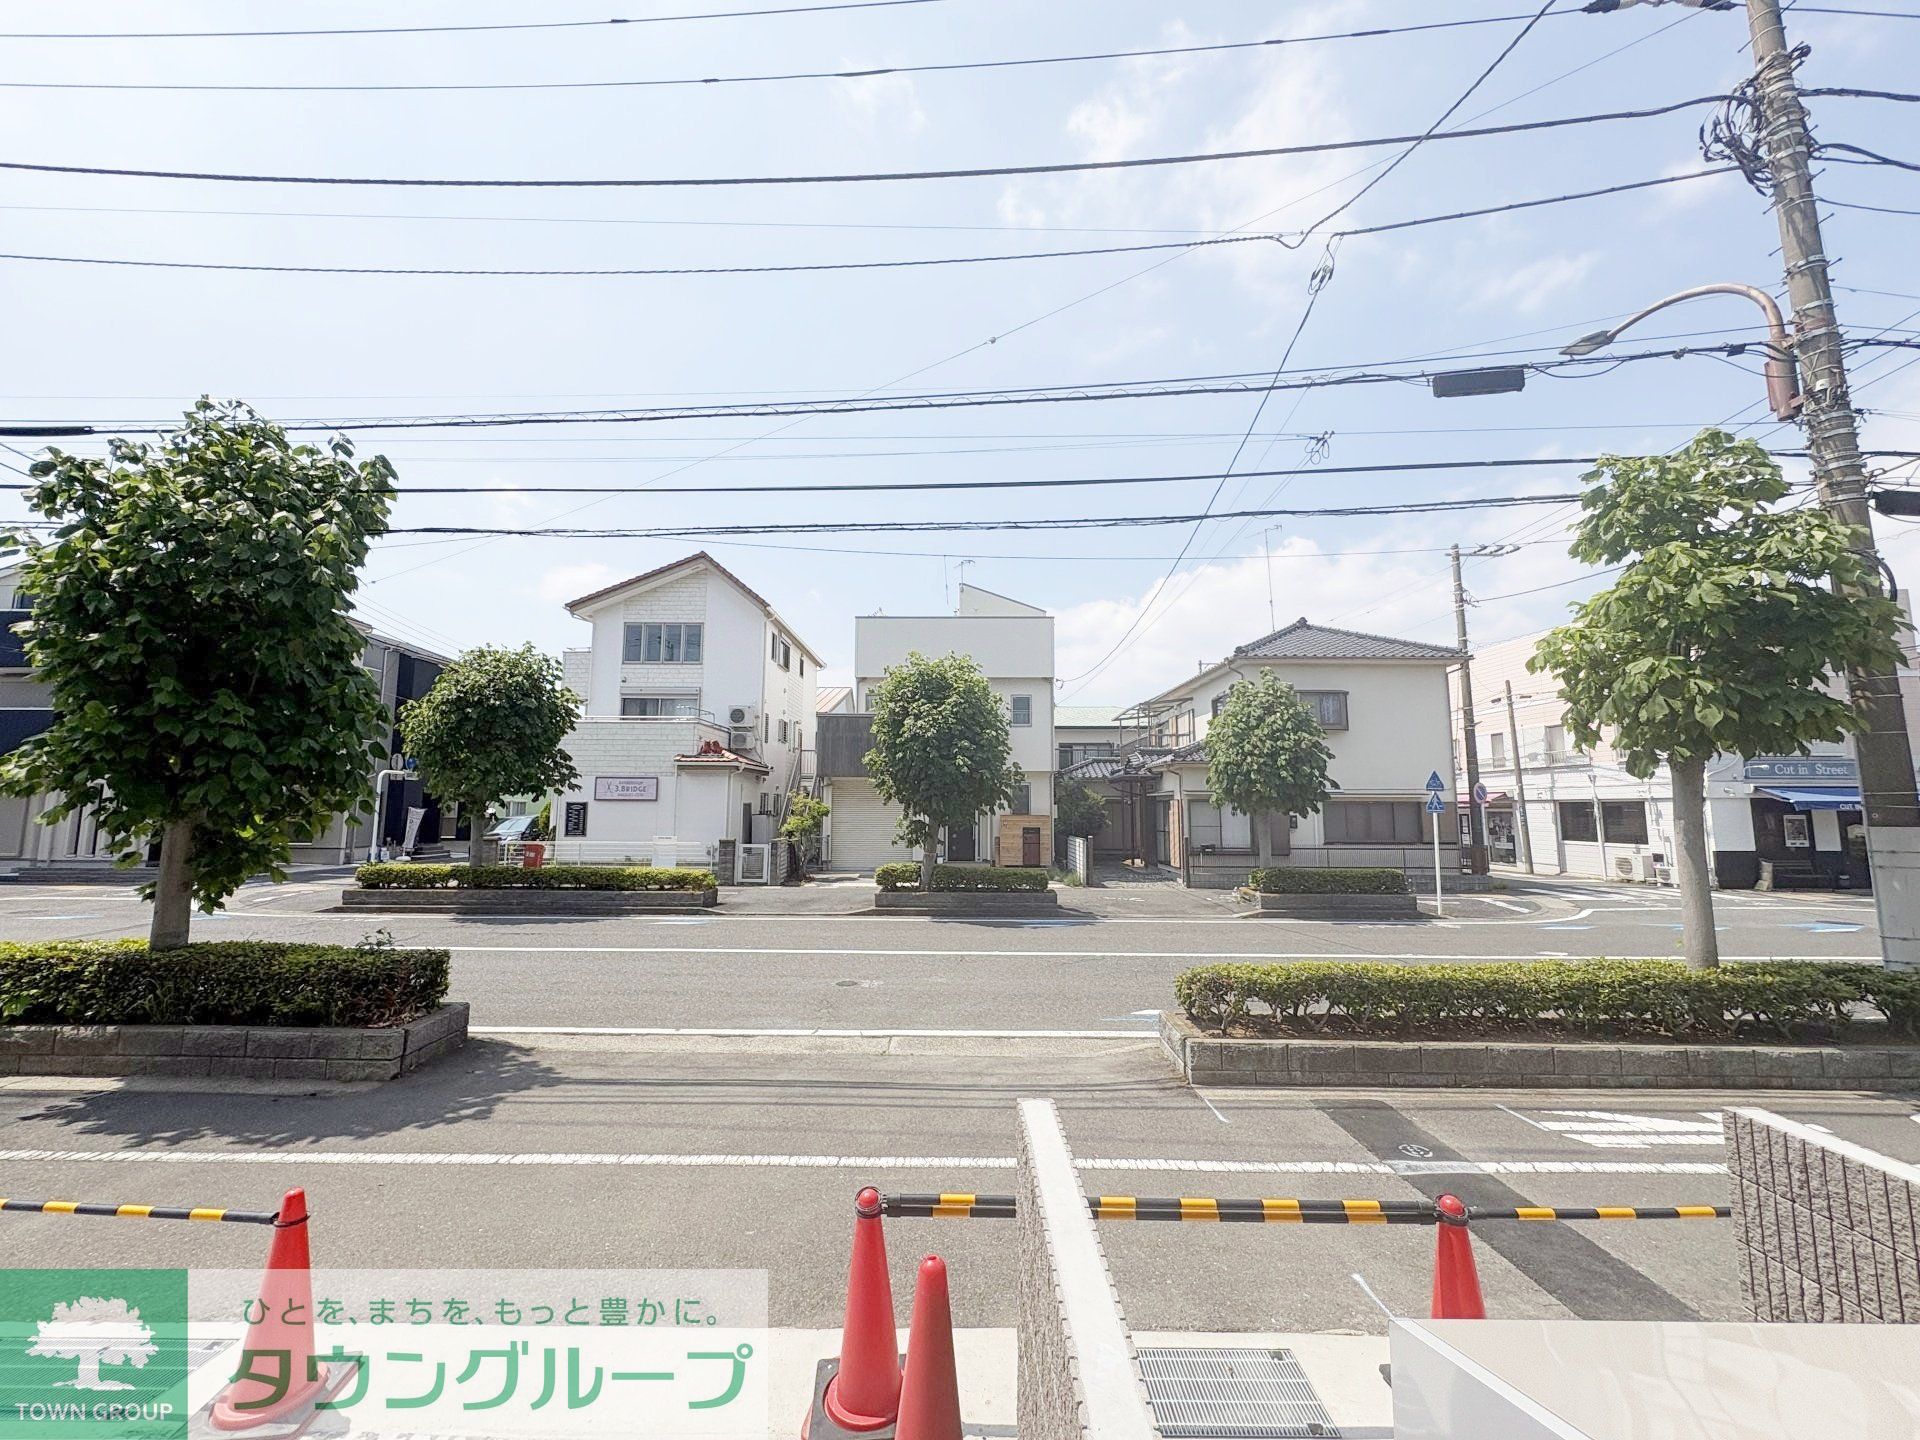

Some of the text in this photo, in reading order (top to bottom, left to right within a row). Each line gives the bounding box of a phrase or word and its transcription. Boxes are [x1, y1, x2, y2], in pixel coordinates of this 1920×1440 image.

[1774, 764, 1849, 775] Cut in Street
